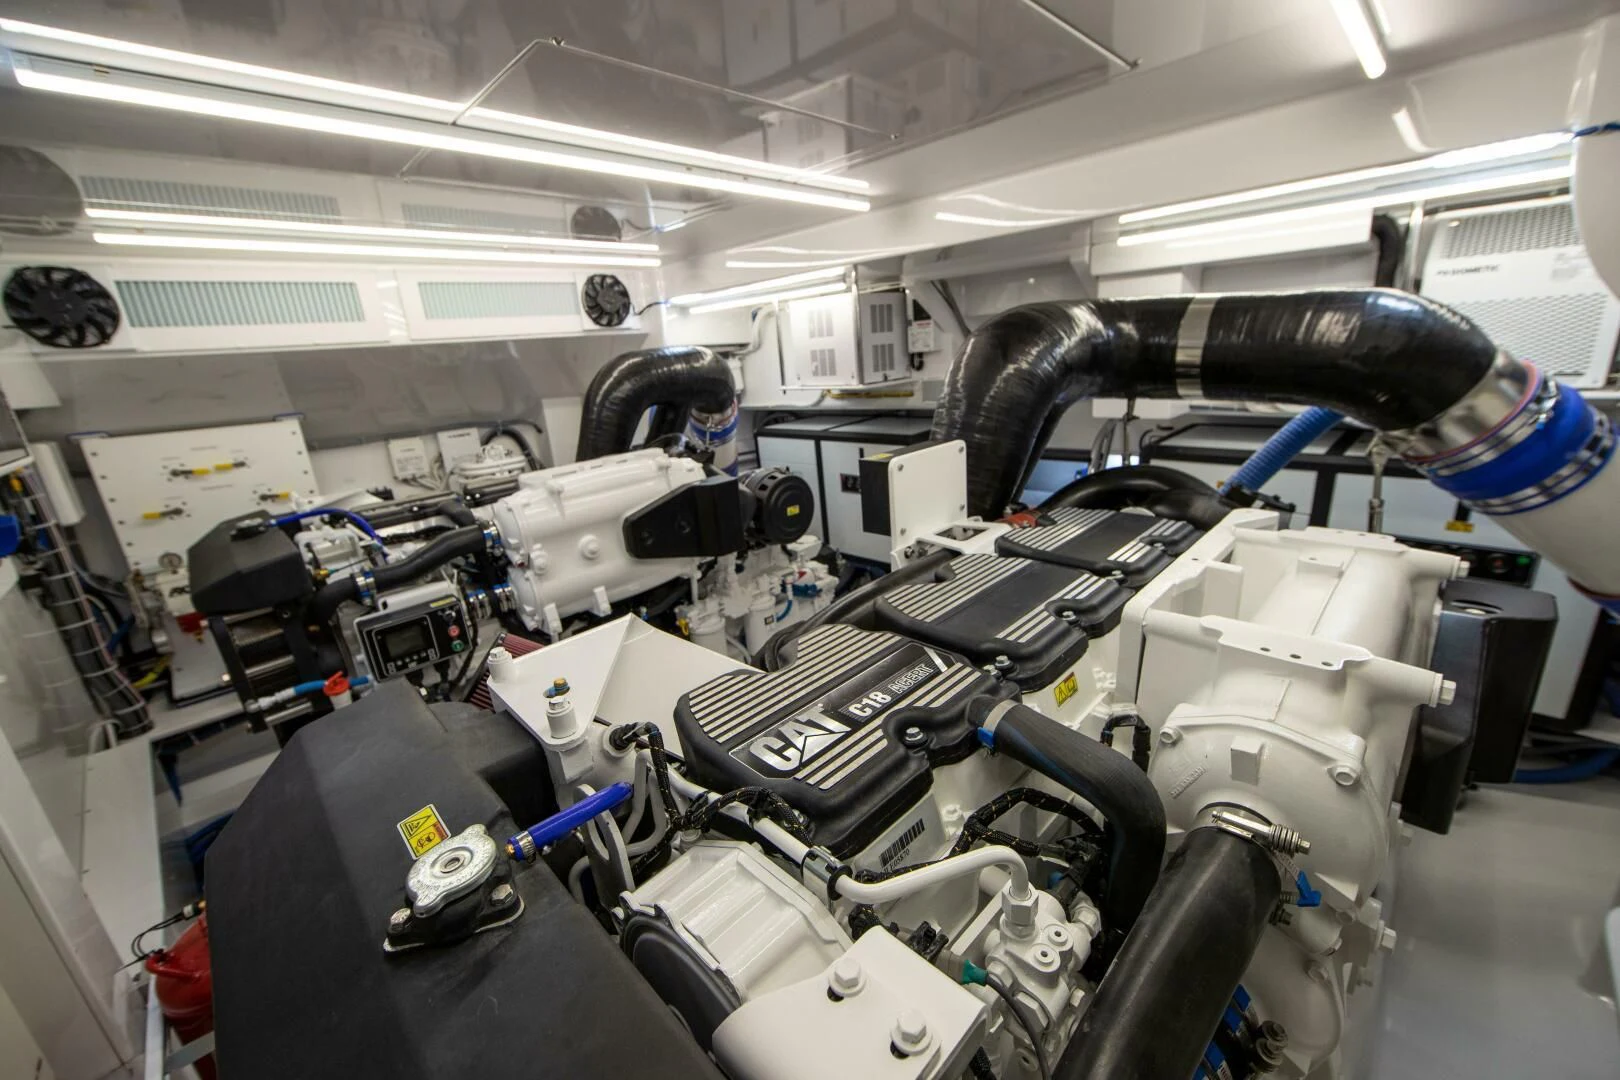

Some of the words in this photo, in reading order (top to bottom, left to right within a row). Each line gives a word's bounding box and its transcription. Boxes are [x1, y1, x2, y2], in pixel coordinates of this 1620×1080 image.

[849, 690, 892, 717] C18
[888, 662, 934, 694] ACERT
[750, 706, 851, 771] CAT
